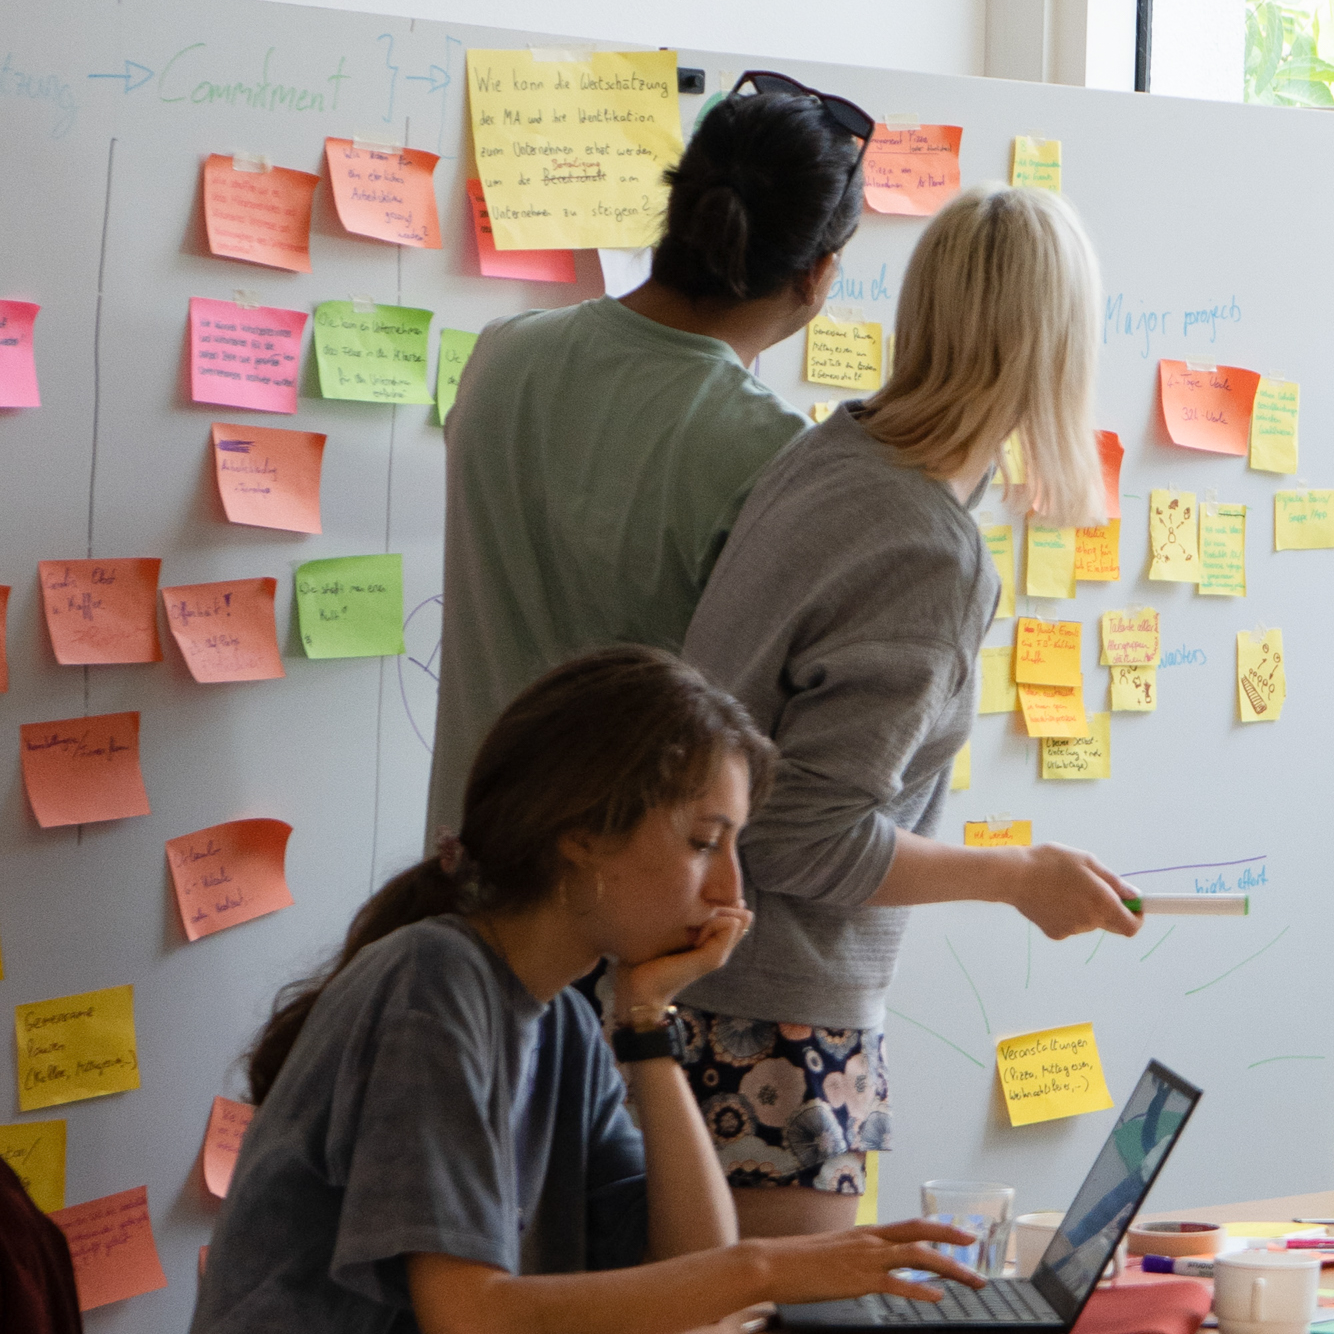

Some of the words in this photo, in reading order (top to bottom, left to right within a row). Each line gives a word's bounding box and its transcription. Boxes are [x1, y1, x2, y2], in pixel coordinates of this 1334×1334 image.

[159, 42, 352, 113] Commitment
[474, 67, 502, 93] Wie
[513, 68, 544, 90] kann
[554, 71, 570, 91] die
[503, 108, 521, 125] MA
[907, 130, 929, 144] Pizza
[513, 141, 574, 158] Unternehmen
[1103, 292, 1171, 360] Major
